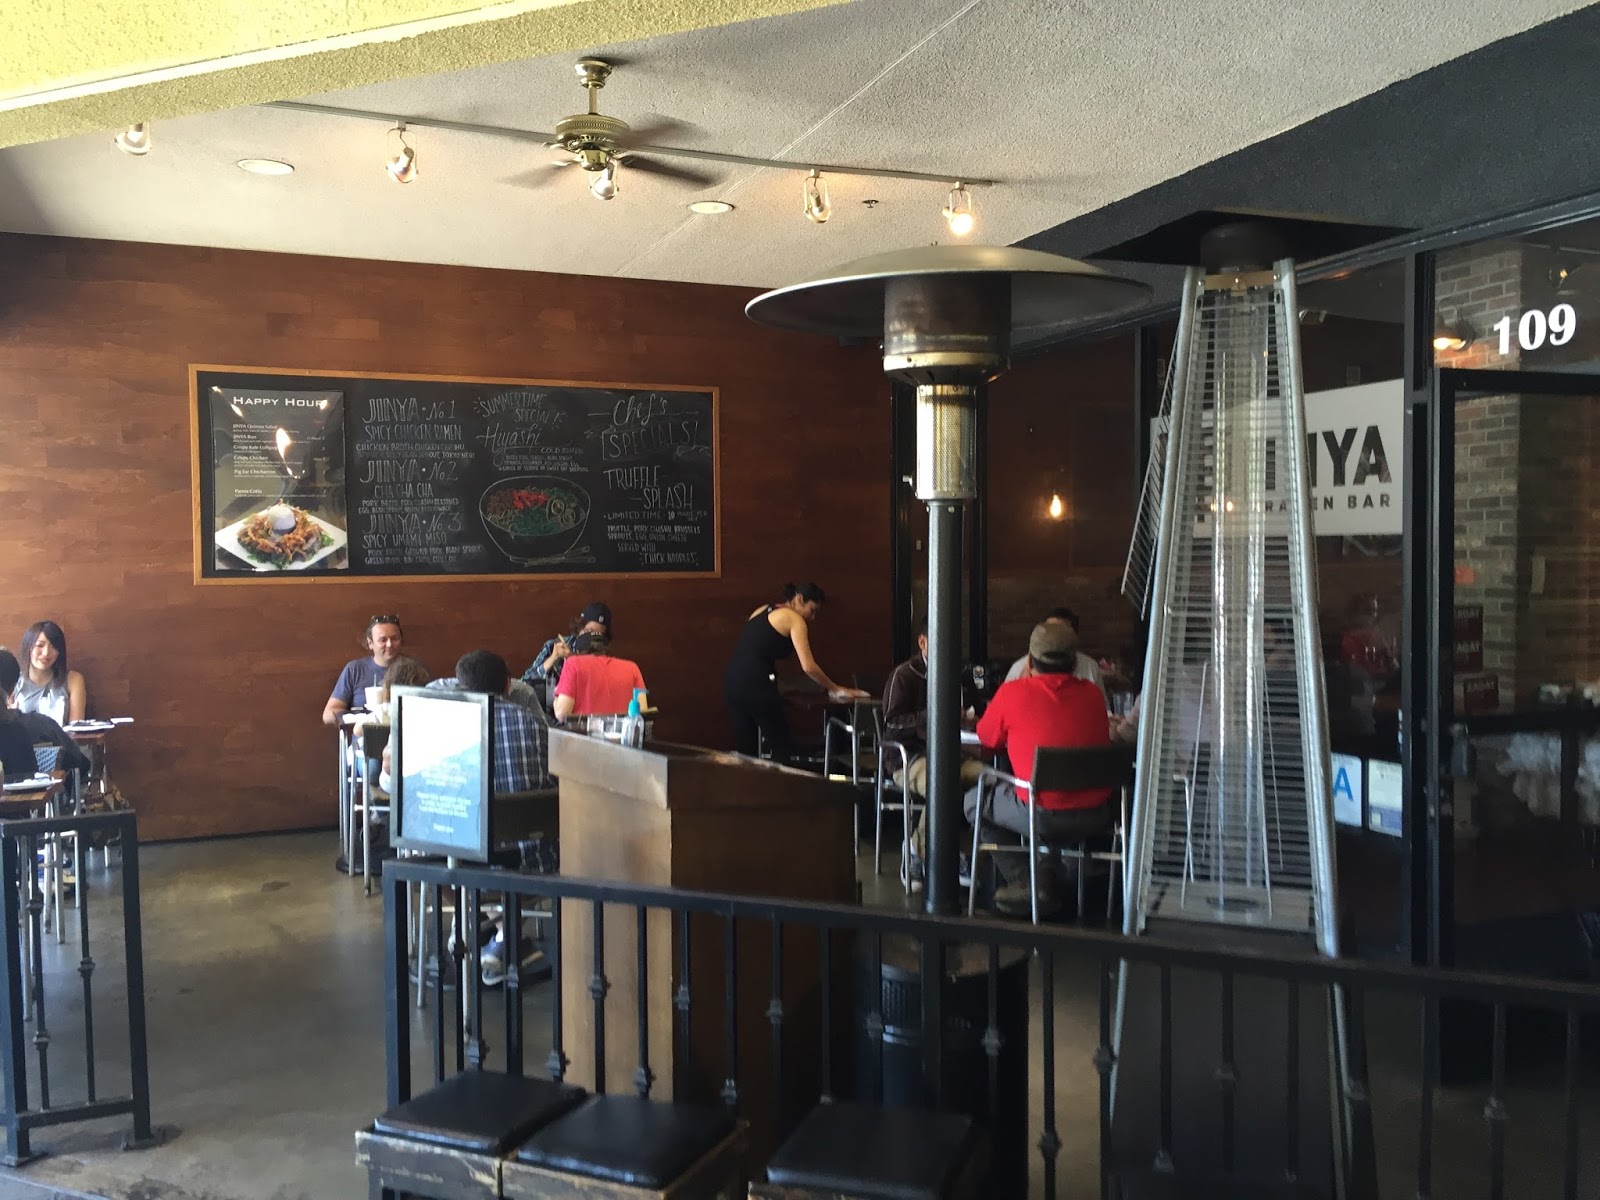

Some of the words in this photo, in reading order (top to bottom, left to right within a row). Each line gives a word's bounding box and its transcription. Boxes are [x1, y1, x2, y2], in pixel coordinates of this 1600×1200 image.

[1493, 303, 1578, 355] 109
[233, 396, 279, 406] HAPPY
[480, 392, 548, 417] SUMMERTIME
[614, 393, 667, 426] Chef's
[365, 424, 391, 440] SPICY
[603, 466, 661, 490] TRUFFLE
[416, 483, 434, 498] CHA
[1347, 493, 1391, 510] BAR
[607, 511, 640, 520] LIMITED
[425, 532, 447, 546] MISO
[617, 543, 640, 552] SERVED
[1333, 767, 1354, 802] A
